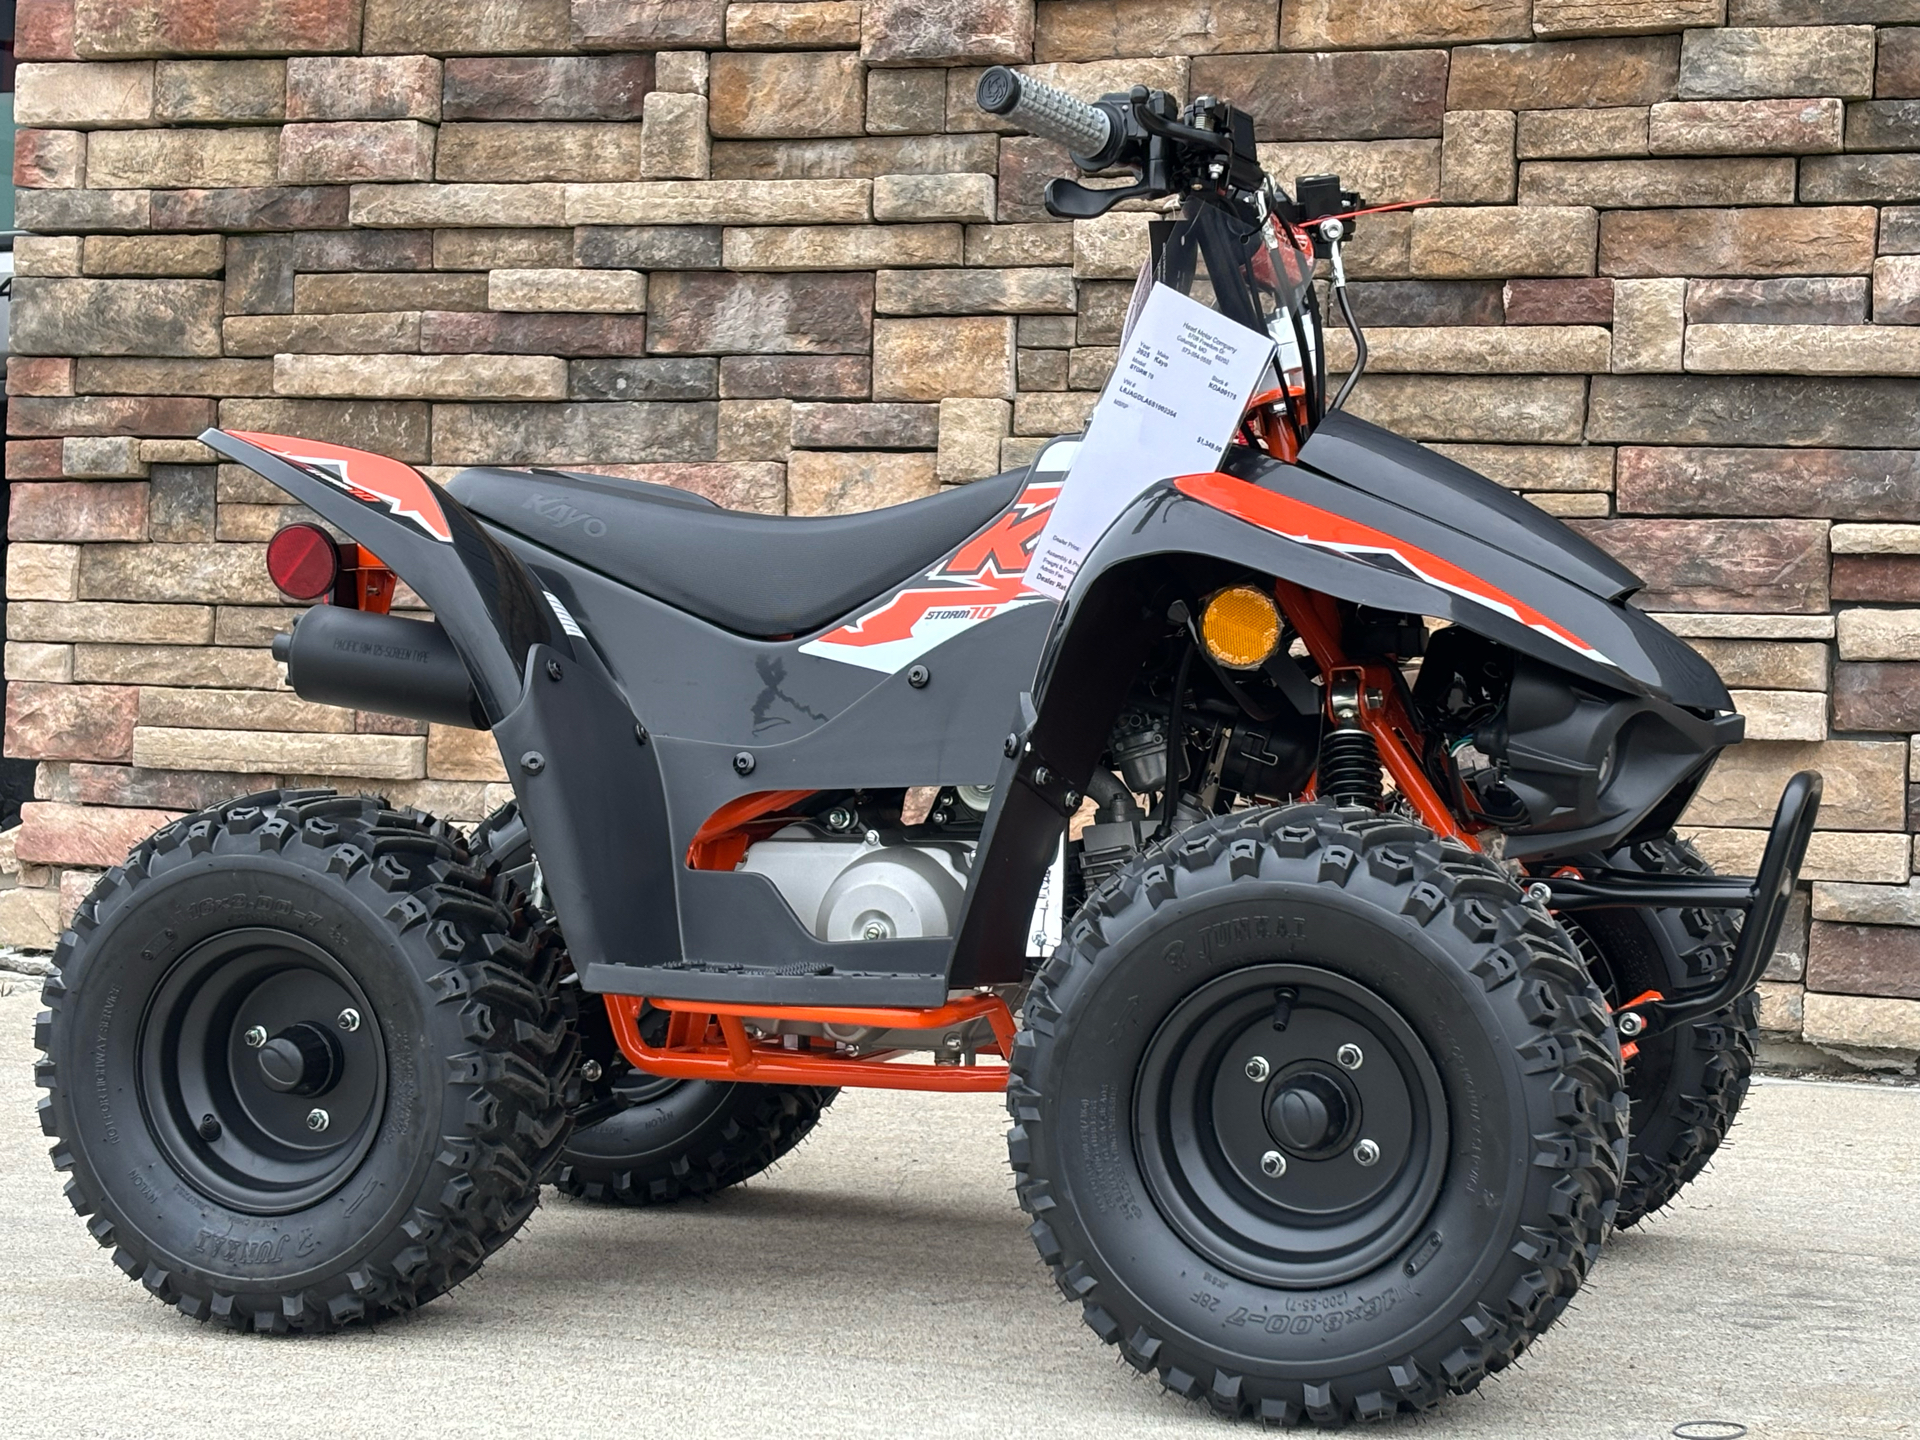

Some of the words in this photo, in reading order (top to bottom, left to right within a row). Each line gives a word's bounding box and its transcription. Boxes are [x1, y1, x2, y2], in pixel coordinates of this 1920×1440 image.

[1176, 335, 1197, 349] Columbia
[1198, 329, 1212, 340] Motor
[1212, 336, 1238, 354] Company
[1199, 338, 1218, 352] Freedom
[1140, 341, 1151, 350] Year
[1157, 350, 1170, 360] Make
[1132, 356, 1146, 367] Model
[1136, 348, 1150, 358] 2025
[1154, 356, 1168, 368] Kayo
[1130, 364, 1148, 376] STORM
[1124, 377, 1132, 386] VIN
[1052, 535, 1068, 546] Dealer
[1043, 557, 1059, 568] Freight
[1046, 550, 1068, 563] Assembly
[1040, 565, 1054, 574] Admin
[1055, 571, 1064, 579] Fee
[1036, 573, 1056, 586] Dealer
[413, 650, 430, 663] TYPE
[100, 985, 122, 1034] SERVICE
[95, 1035, 108, 1096] HIGHWAY
[100, 1096, 113, 1120] FOR
[644, 1110, 674, 1129] NYLON
[104, 1120, 120, 1144] NOT
[128, 1168, 158, 1204] NYLON
